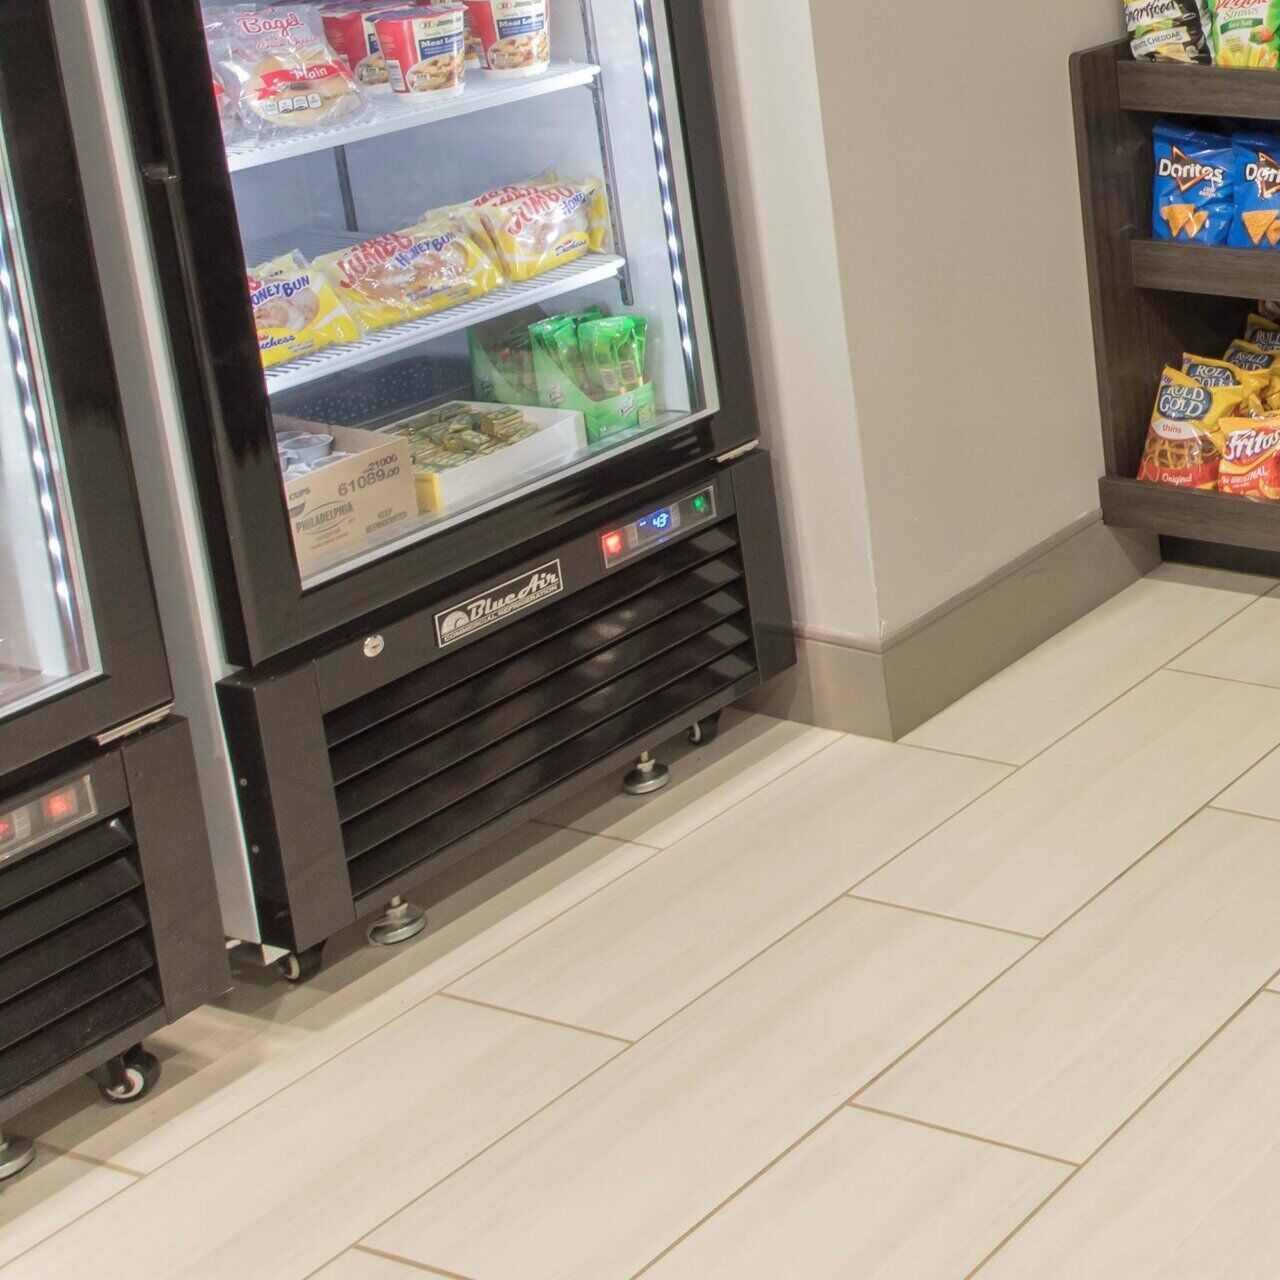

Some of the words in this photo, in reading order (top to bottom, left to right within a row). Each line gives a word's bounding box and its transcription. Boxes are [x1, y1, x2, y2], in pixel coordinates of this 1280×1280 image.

[1147, 30, 1181, 44] CHEDDAR
[1159, 159, 1224, 182] Doritos
[554, 237, 588, 258] Duchess
[252, 282, 283, 305] ONEY
[282, 275, 310, 298] BUN
[1159, 395, 1205, 417] GOLD
[289, 488, 311, 501] CUPS
